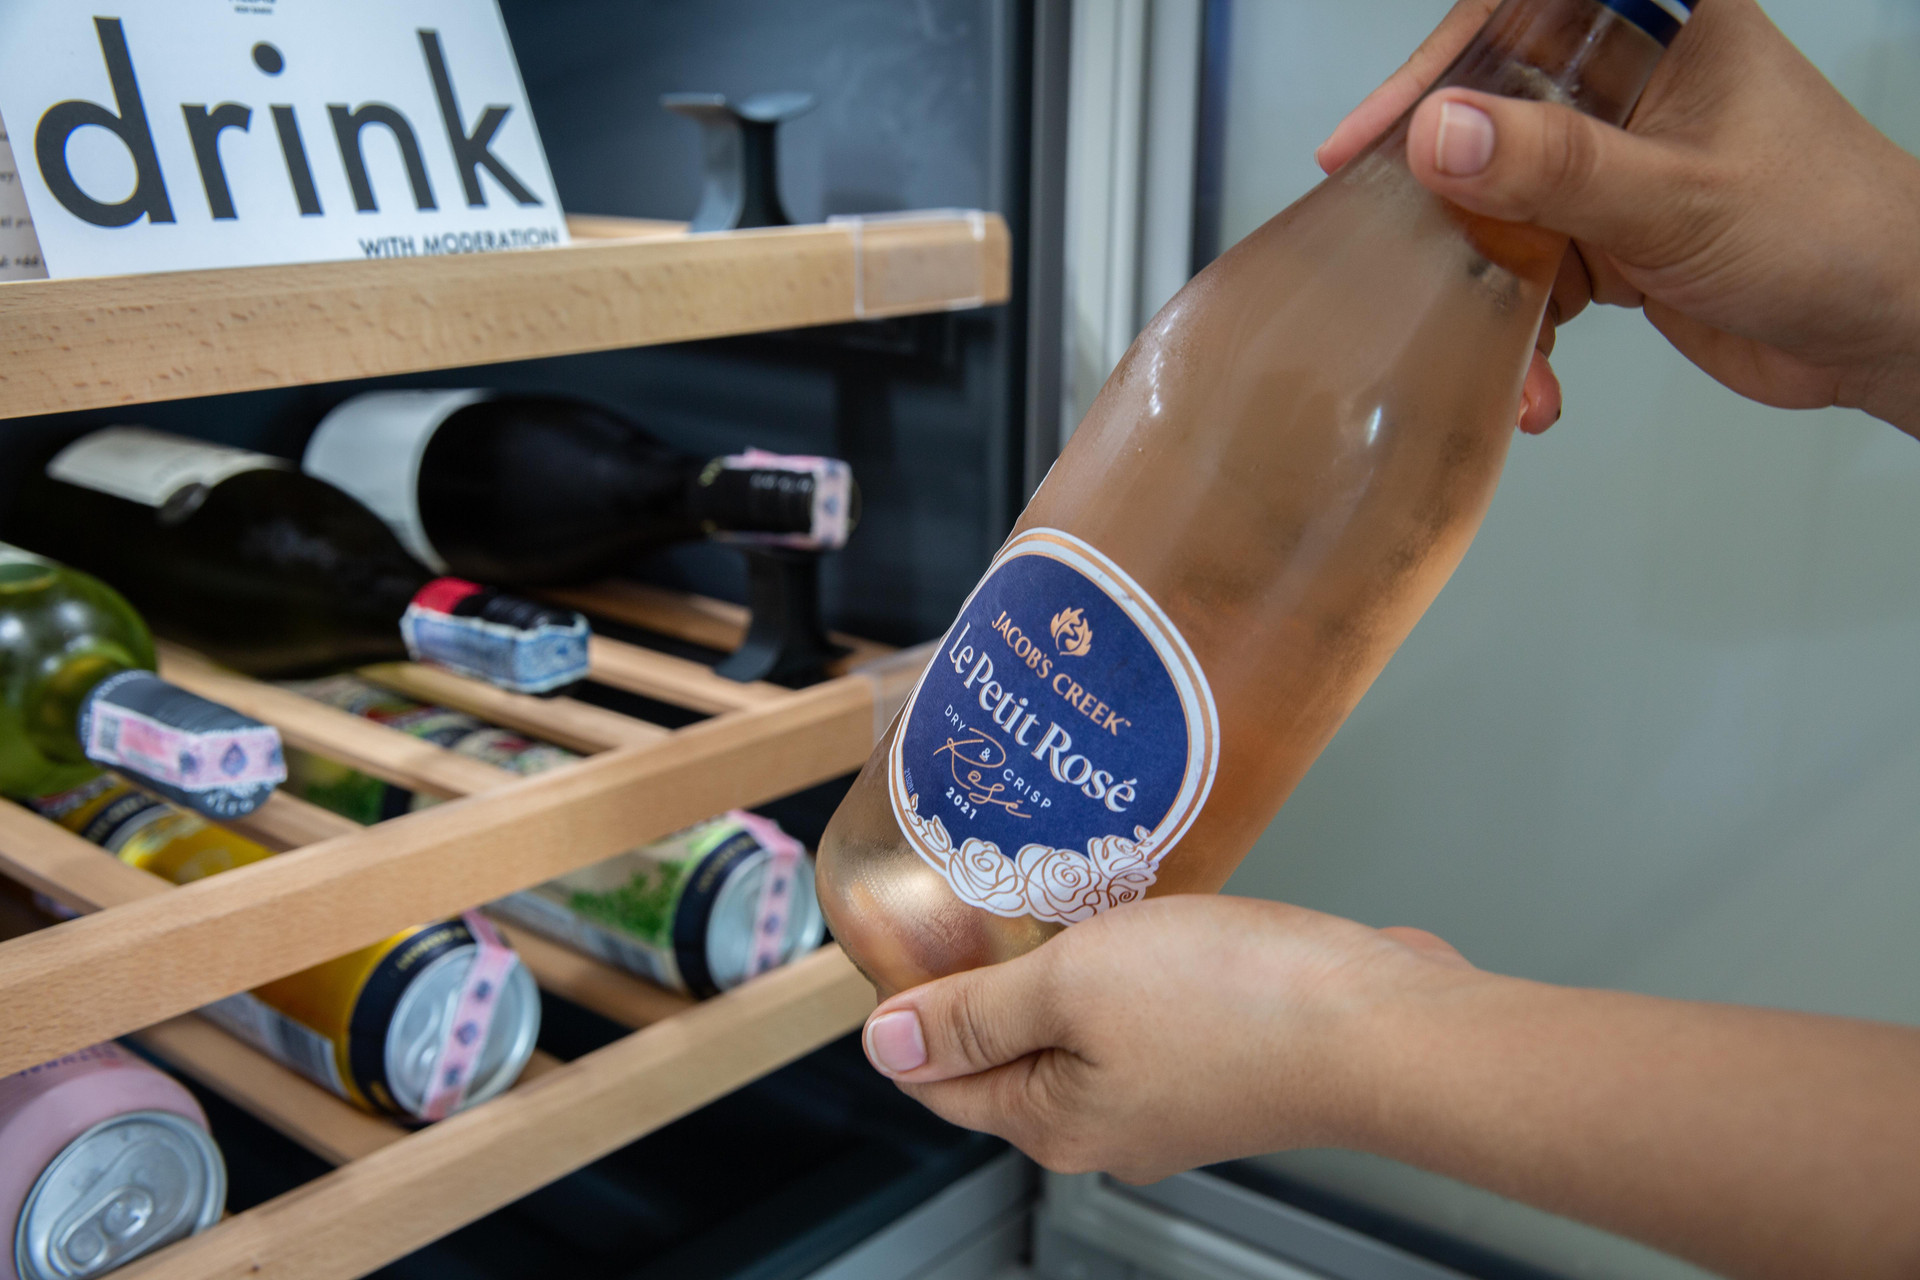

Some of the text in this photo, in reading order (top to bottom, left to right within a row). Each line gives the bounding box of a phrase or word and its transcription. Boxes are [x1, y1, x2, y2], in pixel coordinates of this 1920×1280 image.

[34, 16, 545, 229] drink
[358, 226, 560, 259] WITH MODERATION
[991, 610, 1053, 679] JACOB'S
[944, 704, 1052, 809] DRY & CRISP
[1031, 721, 1138, 813] Rosé
[945, 786, 978, 820] 2021
